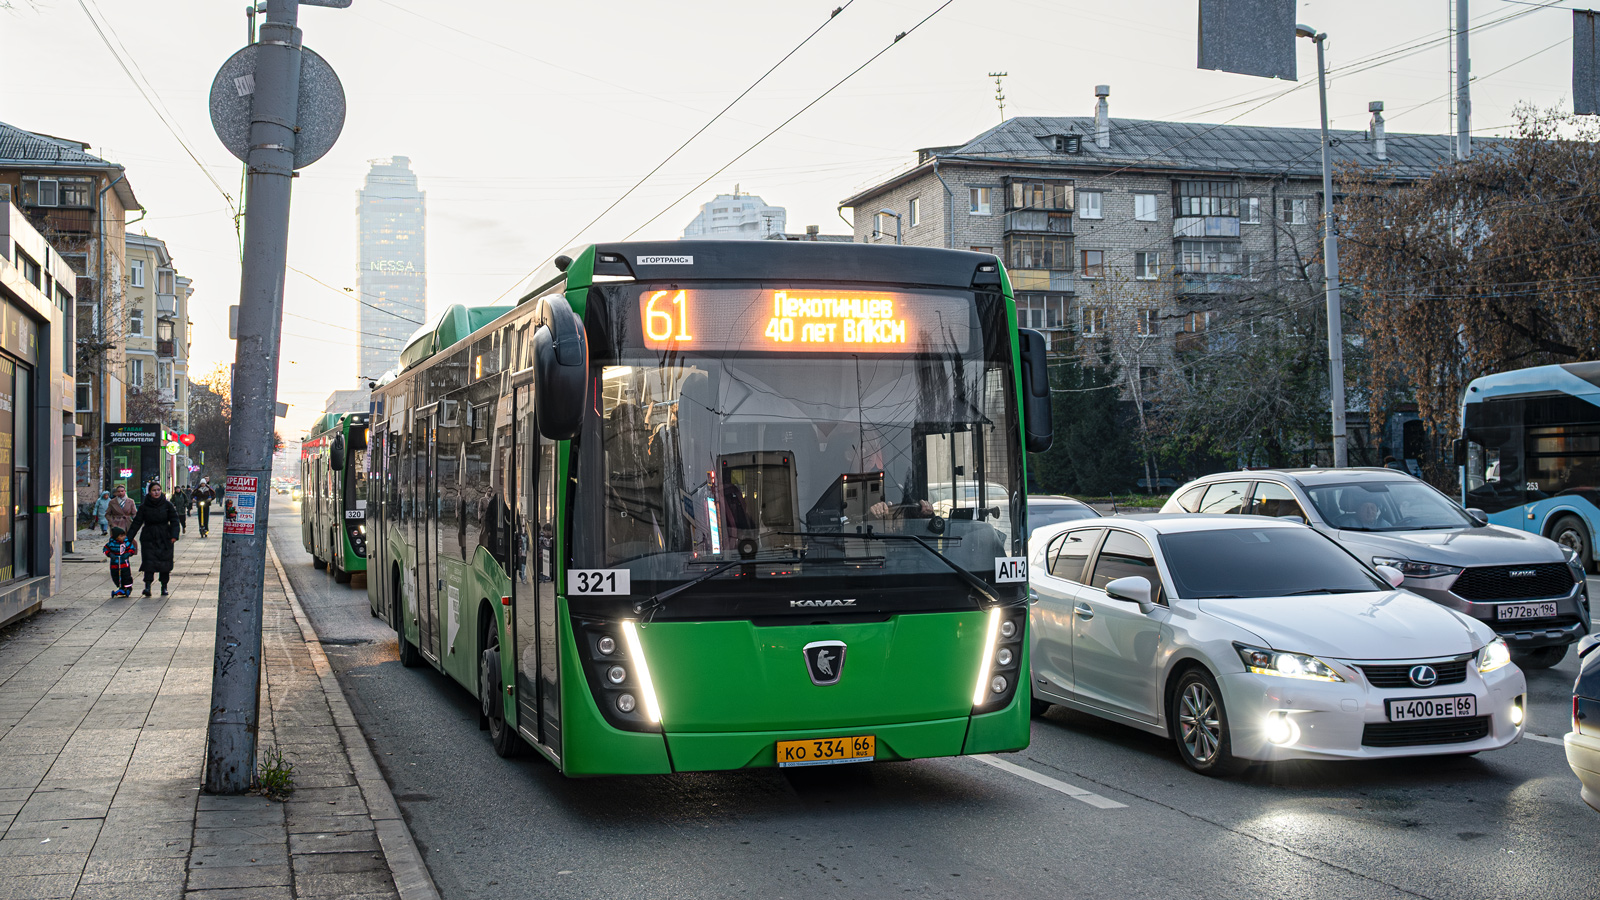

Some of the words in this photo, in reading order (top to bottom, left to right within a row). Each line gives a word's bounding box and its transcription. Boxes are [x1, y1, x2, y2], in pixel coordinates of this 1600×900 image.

[370, 259, 415, 271] NESSA
[641, 256, 689, 264] «ГОРТРАНС»
[774, 291, 893, 319] Пехотинцев
[645, 289, 692, 341] 61
[765, 318, 794, 342] 40
[801, 322, 836, 342] лет
[843, 318, 906, 343] ВЛКСМ
[1526, 482, 1539, 490] 253
[998, 560, 1026, 579] АП-2
[577, 572, 616, 592] 321
[790, 599, 857, 607] KAMAZ
[1540, 604, 1554, 613] 196
[1457, 698, 1471, 710] 66
[813, 740, 844, 758] 334
[854, 737, 869, 750] 66
